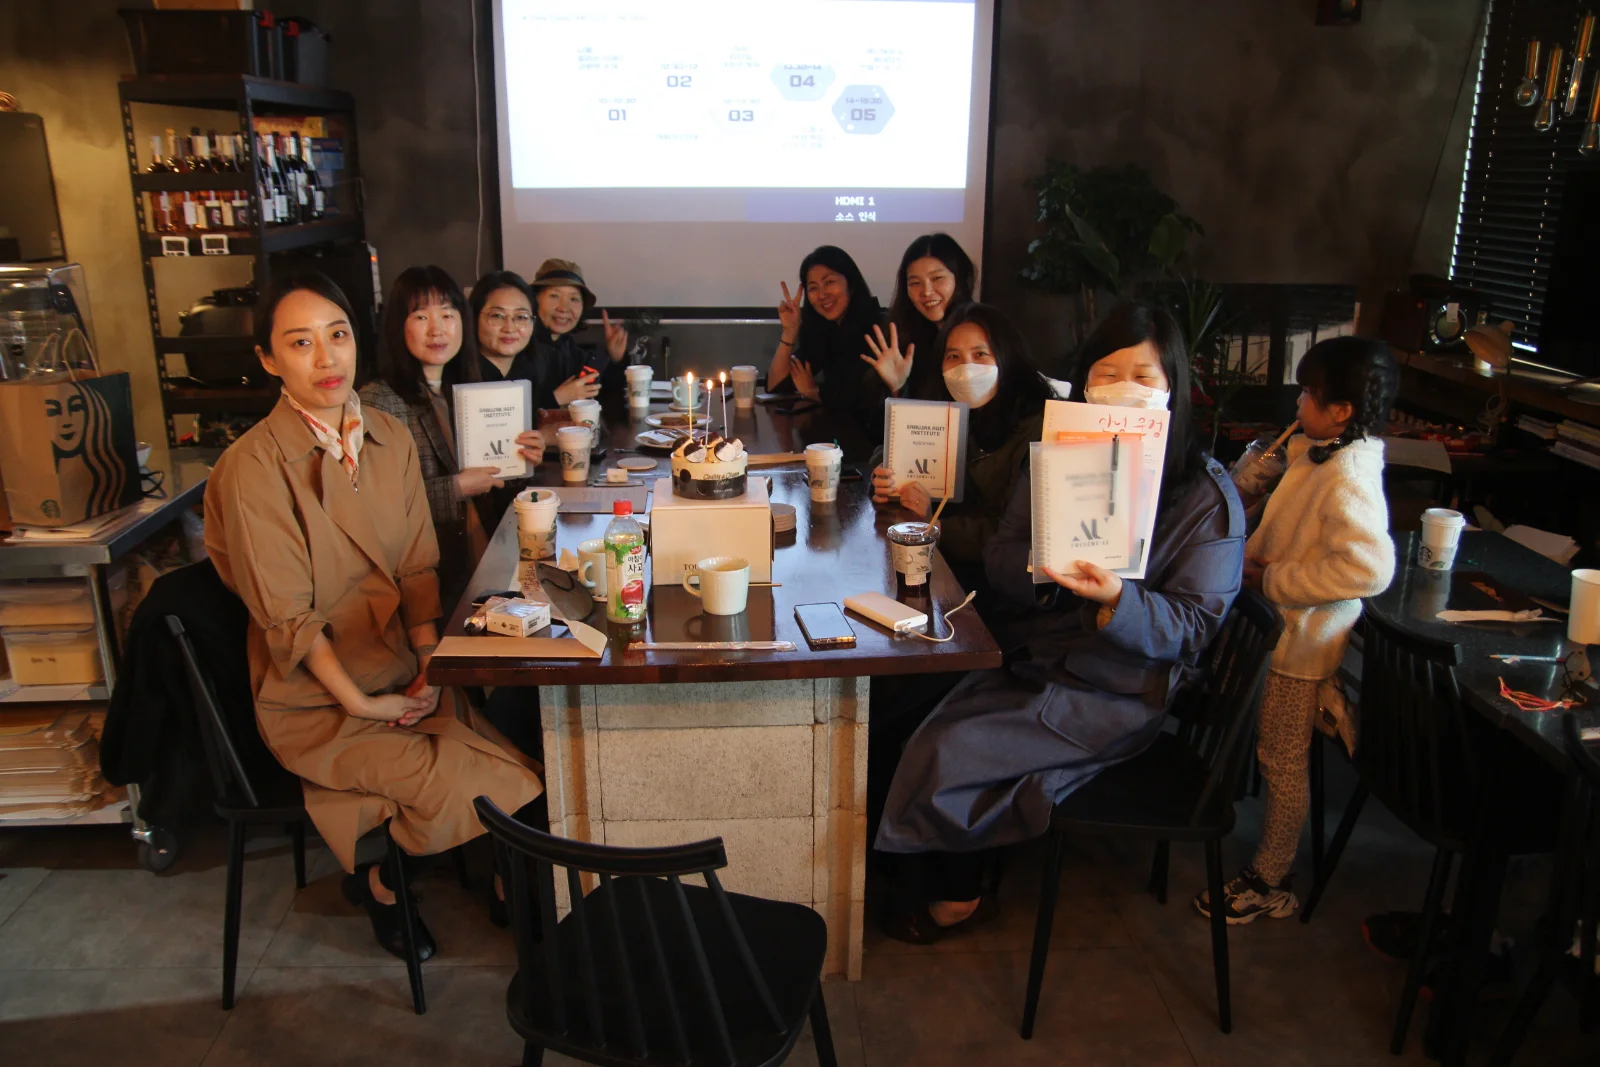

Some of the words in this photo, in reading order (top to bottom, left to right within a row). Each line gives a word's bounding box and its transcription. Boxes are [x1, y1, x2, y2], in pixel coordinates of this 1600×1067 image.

[666, 75, 692, 88] 02
[789, 75, 815, 88] 04
[608, 109, 626, 121] 01
[728, 109, 754, 122] 03
[850, 108, 876, 121] 05
[835, 196, 865, 206] HDMI
[868, 196, 876, 206] 1
[835, 212, 854, 221] 소스
